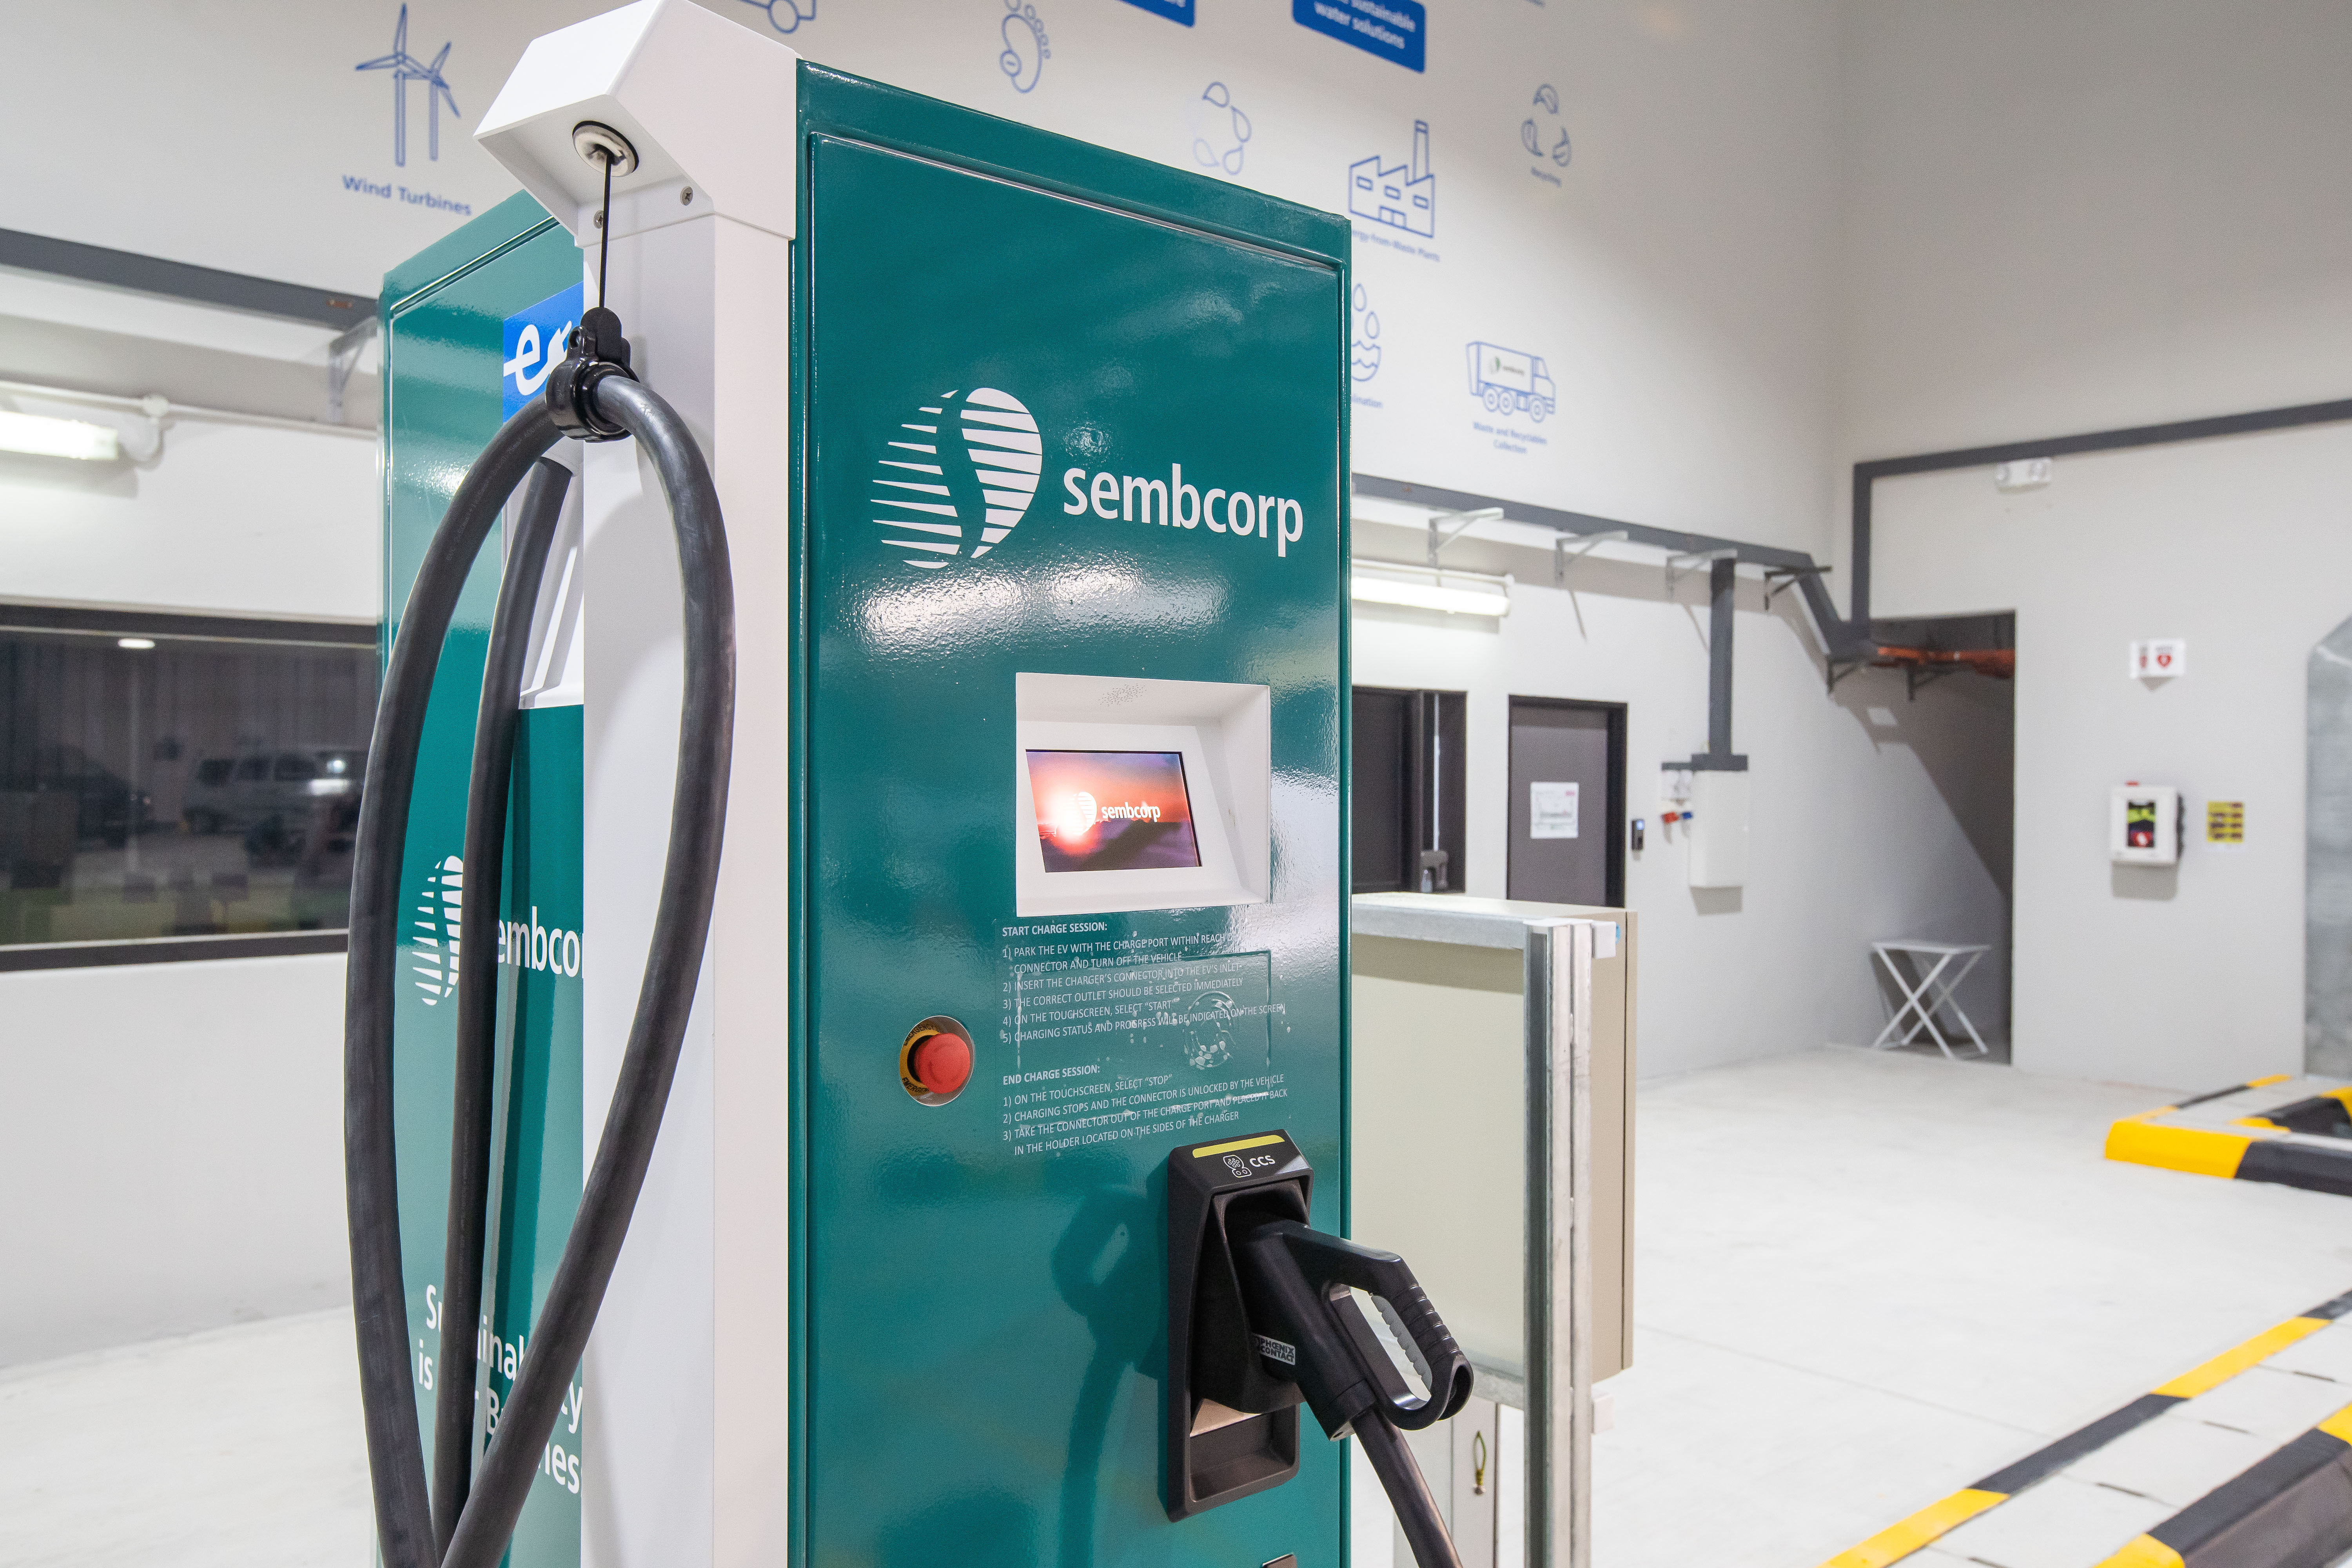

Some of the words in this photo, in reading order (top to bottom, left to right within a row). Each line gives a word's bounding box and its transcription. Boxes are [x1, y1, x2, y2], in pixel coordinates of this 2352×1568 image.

[343, 174, 391, 198] Wind
[397, 186, 472, 216] Turbines
[1064, 463, 1303, 557] sembcorp
[1101, 802, 1161, 822] sembcorp
[1002, 926, 1029, 936] START
[1032, 924, 1067, 935] CHARGE
[1069, 922, 1107, 933] SESSION:
[1002, 947, 1011, 959] 1)
[1014, 946, 1036, 956] PARK
[1039, 945, 1055, 955] THE
[1058, 944, 1068, 954] EV
[1071, 943, 1093, 953] WITH
[1095, 942, 1111, 951] THE
[1114, 939, 1145, 950] CHARGE
[1148, 938, 1168, 948] PORT
[1171, 935, 1199, 946] WITHIN
[1201, 933, 1225, 944] REACH
[1003, 982, 1011, 993] 2)
[1014, 980, 1043, 991] INSERT
[1046, 978, 1062, 988] THE
[1113, 971, 1163, 982] CONNECTOR
[1165, 968, 1183, 979] INTO
[1186, 966, 1200, 976] THE
[1220, 962, 1240, 973] INLET
[1014, 961, 1067, 974] CONNECTOR
[1070, 960, 1088, 969] AND
[1091, 958, 1113, 968] TURN
[1116, 956, 1131, 966] OFF
[1133, 954, 1149, 964] THE
[1151, 952, 1182, 963] VEHICLE
[1003, 999, 1011, 1011] 3)
[1014, 997, 1031, 1007] THE
[1034, 993, 1072, 1006] CORRECT
[1074, 991, 1106, 1002] OUTLET
[1108, 987, 1142, 999] SHOULD
[1144, 984, 1153, 995] BE
[1155, 982, 1192, 994] SELECTED
[1194, 978, 1243, 991] IMMEDIATELY
[1003, 1016, 1011, 1027] 4)
[1014, 1014, 1027, 1025] ON
[1031, 1013, 1047, 1023] THE
[1049, 1006, 1112, 1021] TOUCHSCREEN,
[1115, 1002, 1143, 1014] SELECT
[1003, 1033, 1011, 1044] 5)
[1014, 1028, 1060, 1042] CHARGING
[1063, 1024, 1092, 1036] STATUS
[1094, 1022, 1112, 1033] AND
[1115, 1018, 1156, 1030] PROGRESS
[1158, 1014, 1177, 1026] WILL
[1179, 1013, 1188, 1024] BE
[1190, 1009, 1228, 1022] INDICATED
[1230, 1007, 1242, 1018] ON
[1244, 1005, 1257, 1016] THE
[1259, 1003, 1285, 1015] SCREEN
[1003, 1074, 1022, 1085] END
[1024, 1069, 1060, 1082] CHARGE
[1062, 1065, 1100, 1077] SESSION:
[1003, 1113, 1011, 1124] 2)
[1014, 1106, 1060, 1122] CHARGING
[1063, 1103, 1088, 1114] STOPS
[1091, 1100, 1109, 1110] AND
[1112, 1097, 1127, 1107] THE
[1129, 1091, 1177, 1104] CONNECTOR
[1180, 1088, 1186, 1097] IS
[1188, 1083, 1228, 1096] UNLOCKED
[1230, 1081, 1239, 1090] BY
[1241, 1078, 1254, 1088] THE
[1256, 1074, 1284, 1085] VEHICLE
[1004, 1096, 1011, 1107] 1)
[1014, 1094, 1027, 1105] ON
[1031, 1092, 1047, 1102] THE
[1049, 1083, 1112, 1099] TOUCHSCREEN,
[1115, 1078, 1142, 1091] SELECT
[1003, 1130, 1011, 1142] 3)
[1014, 1127, 1035, 1138] TAKE
[1038, 1124, 1054, 1134] THE
[1057, 1116, 1109, 1132] CONNECTOR
[1111, 1112, 1128, 1123] OUT
[1131, 1111, 1140, 1120] OF
[1143, 1108, 1158, 1118] THE
[1161, 1103, 1191, 1116] CHARGE
[1194, 1100, 1214, 1111] PORT
[1215, 1098, 1231, 1107] AND
[1233, 1094, 1259, 1105] PLACED
[1270, 1089, 1287, 1099] BACK
[1014, 1145, 1024, 1155] IN
[1026, 1143, 1043, 1153] THE
[1046, 1136, 1080, 1150] HOLDER
[1082, 1131, 1118, 1144] LOCATED
[1121, 1128, 1133, 1138] ON
[1136, 1125, 1150, 1136] THE
[1152, 1121, 1174, 1132] SIDES
[1176, 1119, 1186, 1129] OF
[1189, 1116, 1202, 1127] THE
[1205, 1112, 1239, 1124] CHARGER
[1250, 1155, 1276, 1168] CCS
[418, 1339, 433, 1390] is
[1260, 1345, 1295, 1363] CONTACT
